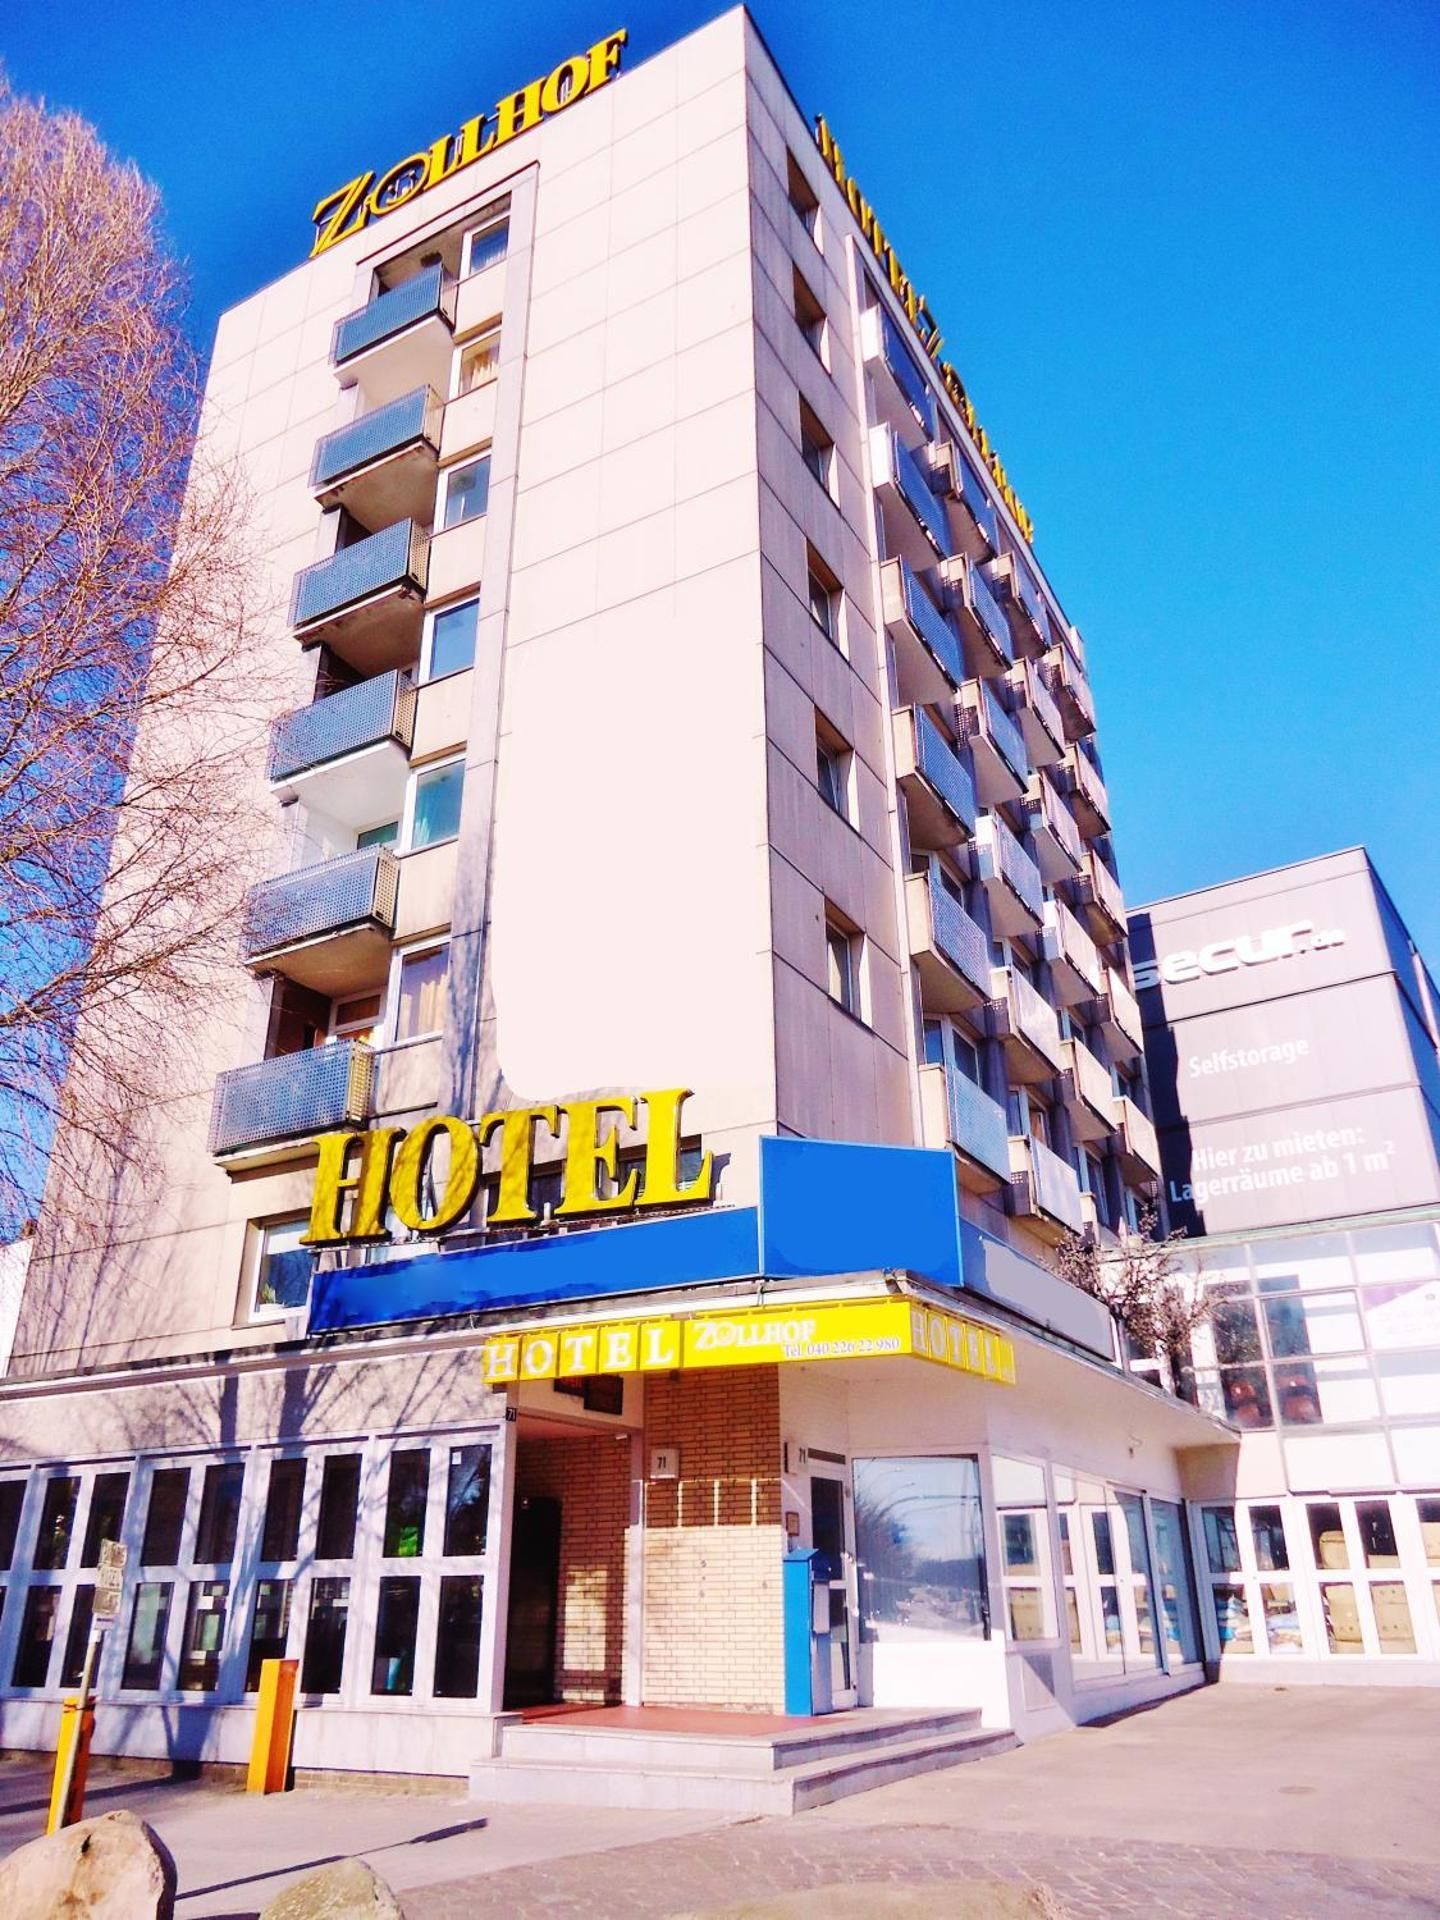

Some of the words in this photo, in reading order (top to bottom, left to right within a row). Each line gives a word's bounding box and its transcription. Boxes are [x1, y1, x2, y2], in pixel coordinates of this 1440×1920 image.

[310, 28, 627, 258] ZOLLHOF
[1189, 1038, 1310, 1078] Selfstorage
[300, 1088, 714, 1244] HOTEL
[1191, 1146, 1242, 1172] Hier
[1243, 1145, 1269, 1163] zu
[1273, 1127, 1366, 1158] mieten:
[1169, 1166, 1306, 1205] Lagerräume
[1309, 1156, 1339, 1181] ab
[1343, 1152, 1357, 1175] 1
[485, 1320, 675, 1379] HOTEL
[693, 1320, 816, 1351] ZOLLHOF
[806, 1342, 830, 1356] 040
[858, 1338, 874, 1353] 22
[876, 1336, 900, 1351] 980
[911, 1310, 996, 1374] HOTEL
[657, 1455, 667, 1469] 71
